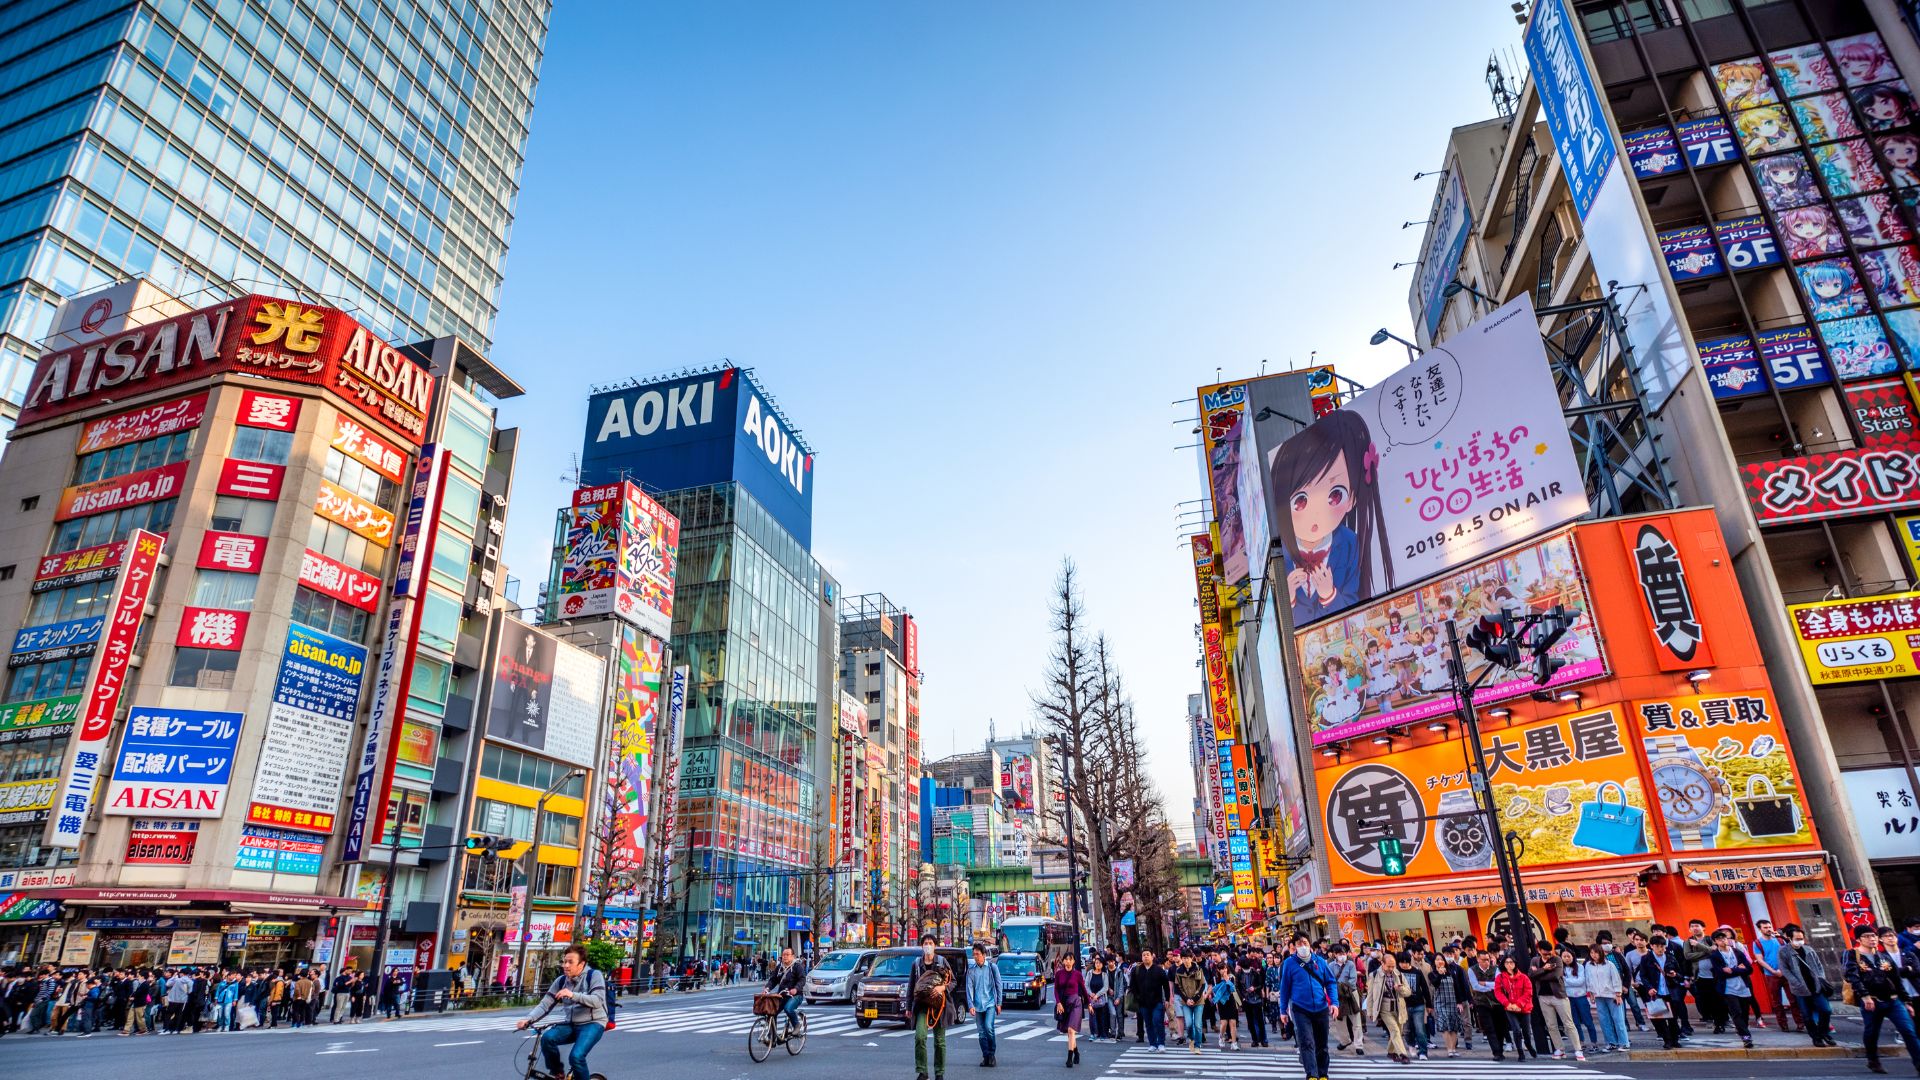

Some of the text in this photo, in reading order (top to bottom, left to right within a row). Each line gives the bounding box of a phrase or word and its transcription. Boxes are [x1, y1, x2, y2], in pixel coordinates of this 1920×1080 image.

[1626, 138, 1673, 154] アメニティ
[1687, 138, 1734, 166] 7F
[1661, 237, 1712, 253] アメニティ
[1726, 239, 1776, 267] 6F
[251, 302, 324, 353] 光
[1488, 307, 1522, 331] KADOKAWA
[25, 306, 234, 410] AISAN
[236, 347, 324, 374] ネットワーク
[342, 325, 432, 415] AISAN
[1702, 350, 1755, 366] アメニティ
[1771, 352, 1823, 384] 5F
[1426, 363, 1448, 406] 友達に
[596, 380, 715, 443] AOKI
[1410, 376, 1432, 427] なりたい
[1855, 404, 1906, 422] Poker
[1861, 417, 1912, 434] Stars
[332, 421, 402, 476] 光通信
[743, 394, 803, 495] AOKI
[1405, 425, 1529, 491] ひとりぼっちの
[71, 474, 175, 514] aisan.co.jp
[579, 486, 619, 505] 免税店
[1763, 451, 1920, 513] メイド
[316, 485, 395, 539] ネットワーク
[1405, 514, 1484, 559] 2019.4.5
[1489, 497, 1521, 522] ON
[1525, 481, 1563, 508] AIR
[397, 480, 427, 581] 愛三電機
[41, 557, 61, 576] 3F
[300, 550, 379, 603] 配線パーツ
[1632, 539, 1703, 647] 質
[1804, 603, 1920, 635] 全身もみほ
[17, 619, 104, 649] 2F ネットワーク
[88, 537, 158, 731] 光・ケーブル・ネットワーク
[289, 637, 363, 676] aisan.co.jp
[1823, 643, 1887, 662] りらくる
[501, 655, 552, 684] Change
[1820, 664, 1906, 680] 秋葉原中央通り店
[364, 608, 402, 766] 各種ケーブル・ネットワーク機器
[672, 671, 684, 712] AKKY
[131, 714, 235, 740] 各種ケーブル
[1482, 710, 1625, 779] 大黒屋
[121, 752, 227, 775] 配線パーツ
[685, 765, 709, 775] OPEN
[58, 751, 98, 834] 愛三電機
[111, 787, 219, 811] AISAN
[1208, 762, 1221, 810] Tax-free
[1876, 788, 1912, 809] 喫茶
[253, 805, 271, 818] 各社
[350, 775, 372, 853] AISAN
[1213, 811, 1225, 839] Shop
[128, 840, 194, 863] aisan.co.jp
[1231, 845, 1248, 853] DVD
[1712, 863, 1823, 881] 1階にて高価買取中
[98, 890, 177, 900] http://www.aisan.co.jp
[1579, 881, 1637, 898] 無料査定
[1843, 892, 1862, 904] 4F
[1317, 901, 1352, 913] 高価買取
